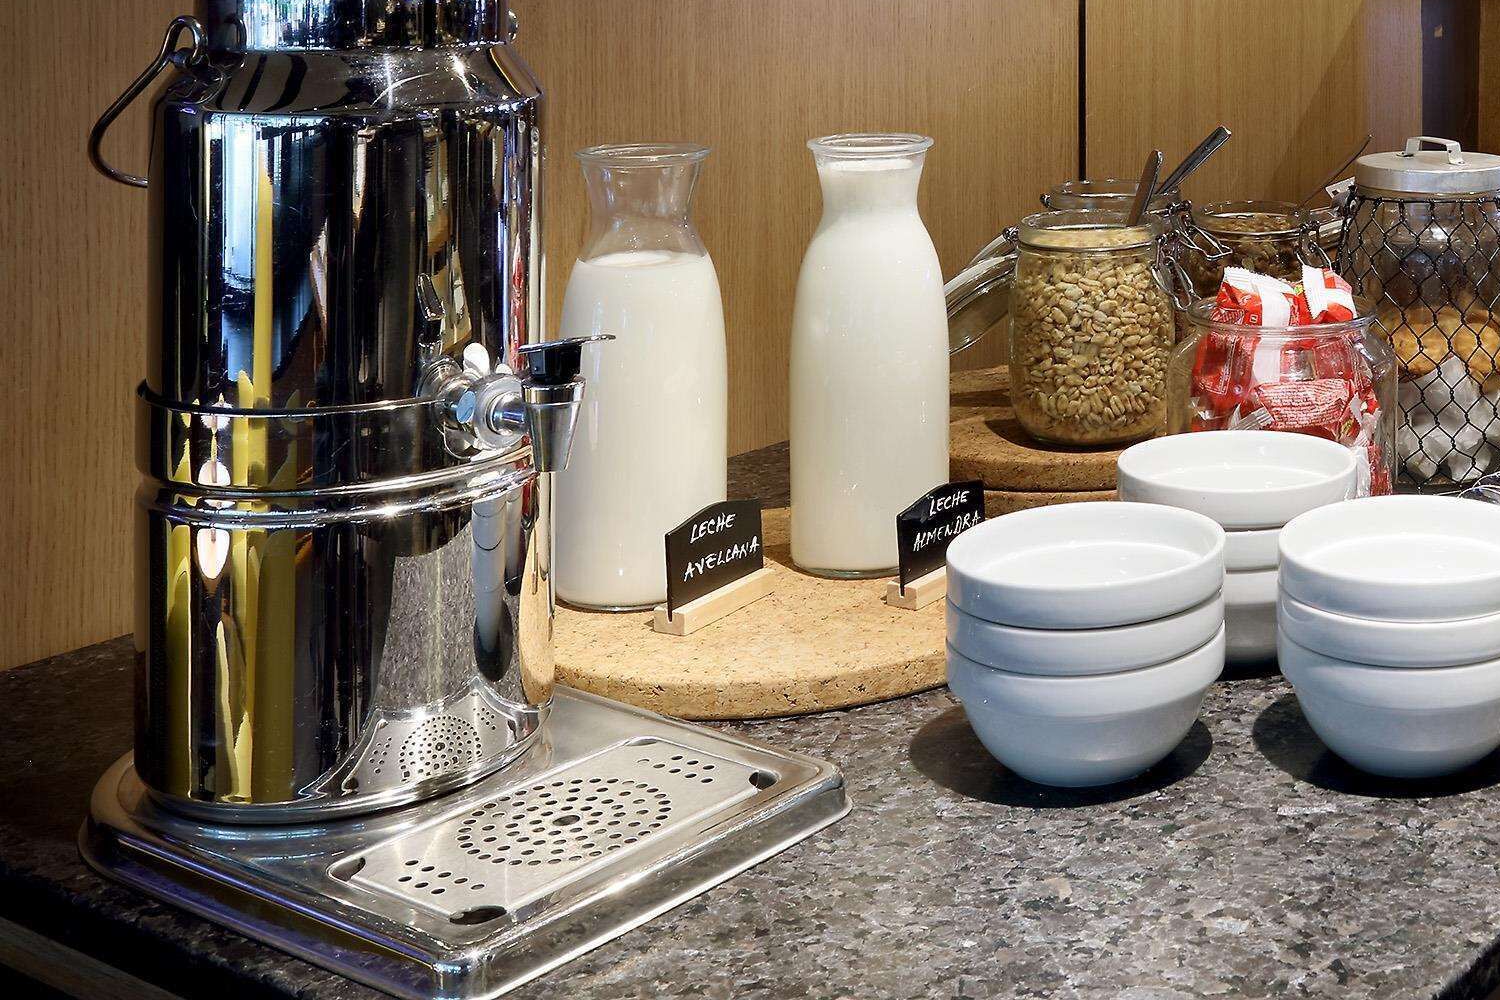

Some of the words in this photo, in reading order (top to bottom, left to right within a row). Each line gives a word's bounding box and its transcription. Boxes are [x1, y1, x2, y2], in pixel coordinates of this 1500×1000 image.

[929, 490, 970, 516] LECHE
[689, 512, 736, 544] LECHE
[913, 509, 981, 552] ALMENDRA
